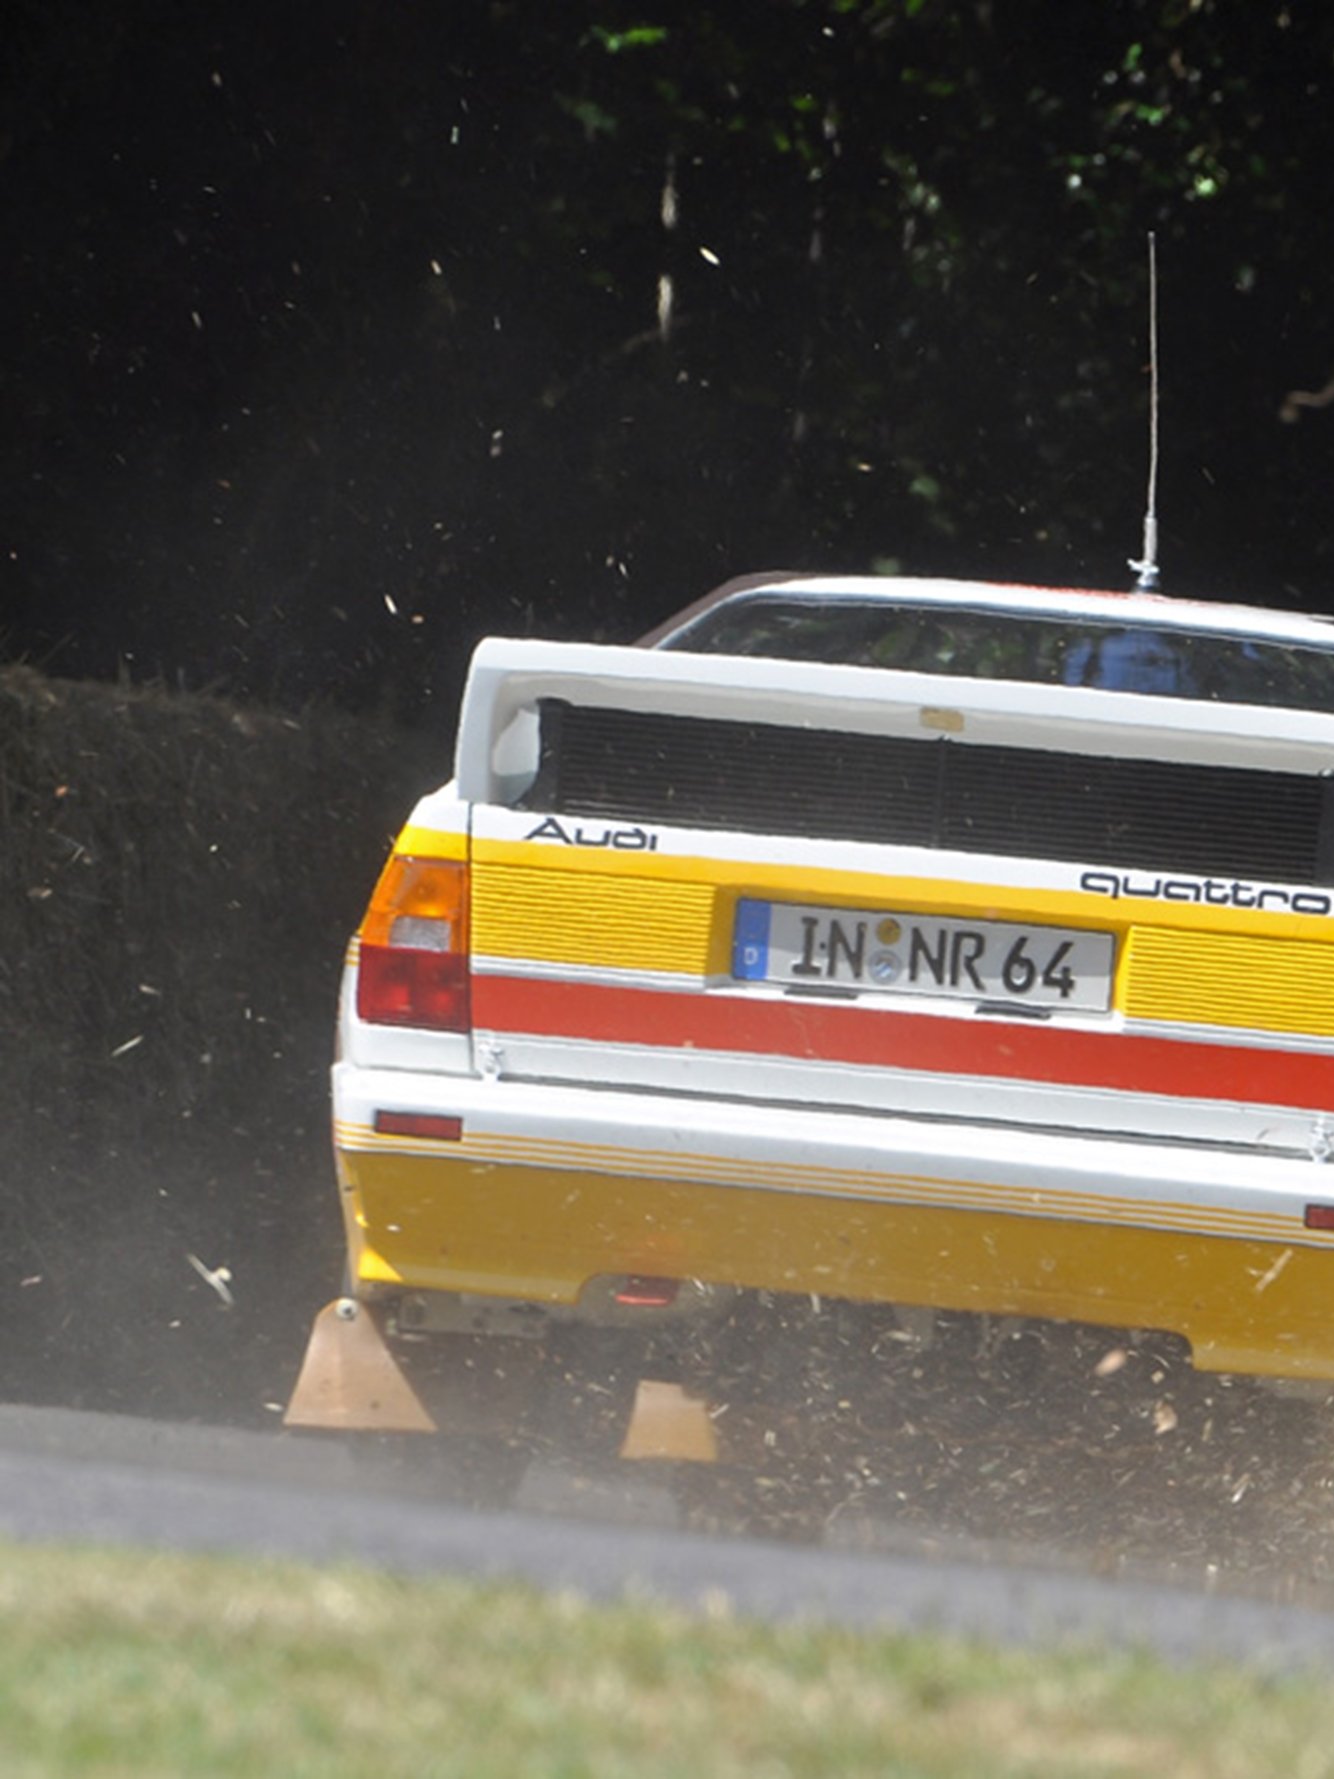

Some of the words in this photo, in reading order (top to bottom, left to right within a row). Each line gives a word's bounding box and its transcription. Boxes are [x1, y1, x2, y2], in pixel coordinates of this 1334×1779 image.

[524, 817, 657, 851] Audi
[1080, 872, 1331, 915] quattro
[909, 926, 986, 991] NR
[1002, 935, 1076, 998] 64
